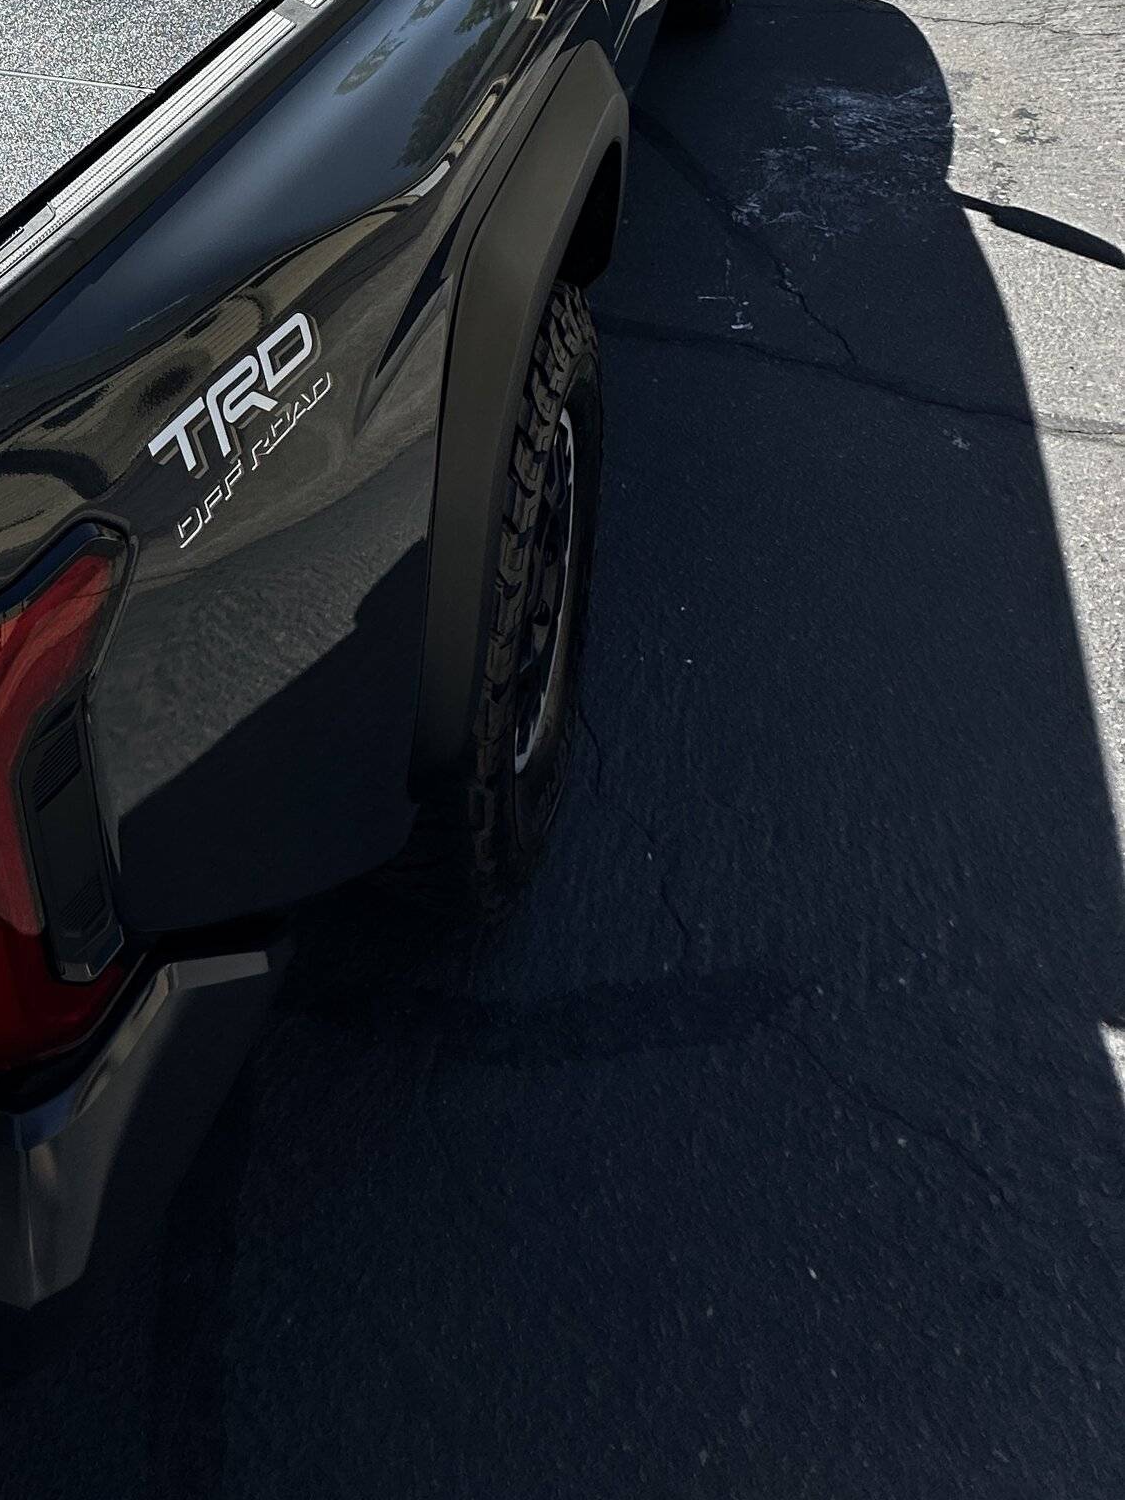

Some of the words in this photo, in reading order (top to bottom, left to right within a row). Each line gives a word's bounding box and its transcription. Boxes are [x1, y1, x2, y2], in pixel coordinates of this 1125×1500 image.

[148, 312, 313, 472] TRD
[177, 459, 245, 549] OFF
[251, 371, 332, 471] ROAD
